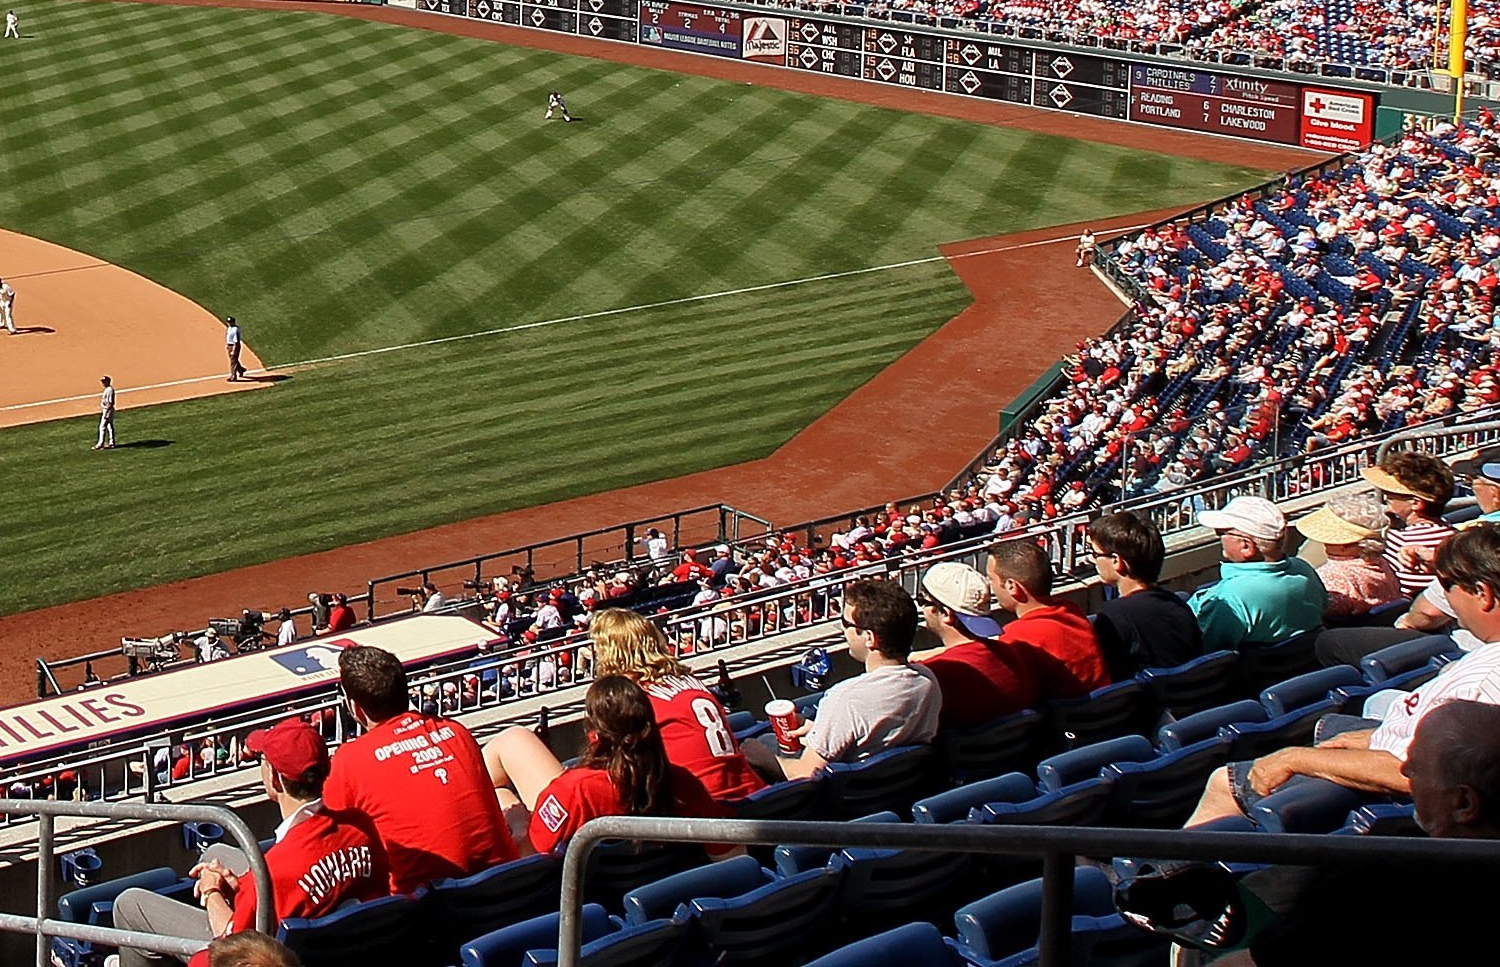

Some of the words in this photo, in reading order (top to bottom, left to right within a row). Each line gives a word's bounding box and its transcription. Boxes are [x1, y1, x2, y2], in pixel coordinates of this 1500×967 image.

[822, 35, 838, 46] WSH
[904, 35, 913, 45] SF
[744, 40, 780, 54] Majestic
[902, 47, 916, 58] FLA
[988, 47, 1002, 58] MIL
[822, 50, 836, 61] CHC
[822, 62, 834, 72] PIT
[902, 61, 915, 73] ARI
[989, 58, 999, 70] LA
[900, 73, 916, 84] HOU
[1146, 68, 1196, 82] CARDINALS
[1226, 78, 1268, 94] xfinity
[1146, 78, 1190, 90] PHILLIES
[1140, 92, 1173, 104] READING
[1221, 104, 1275, 120] CHARLESTON
[1329, 100, 1360, 109] American
[1140, 104, 1180, 118] PORTLAND
[1220, 116, 1266, 130] LAKEWOOD
[1310, 119, 1328, 128] Give
[1330, 120, 1356, 131] blood.
[692, 698, 734, 757] 8
[374, 736, 428, 760] OPENING
[298, 846, 371, 904] HOWARD
